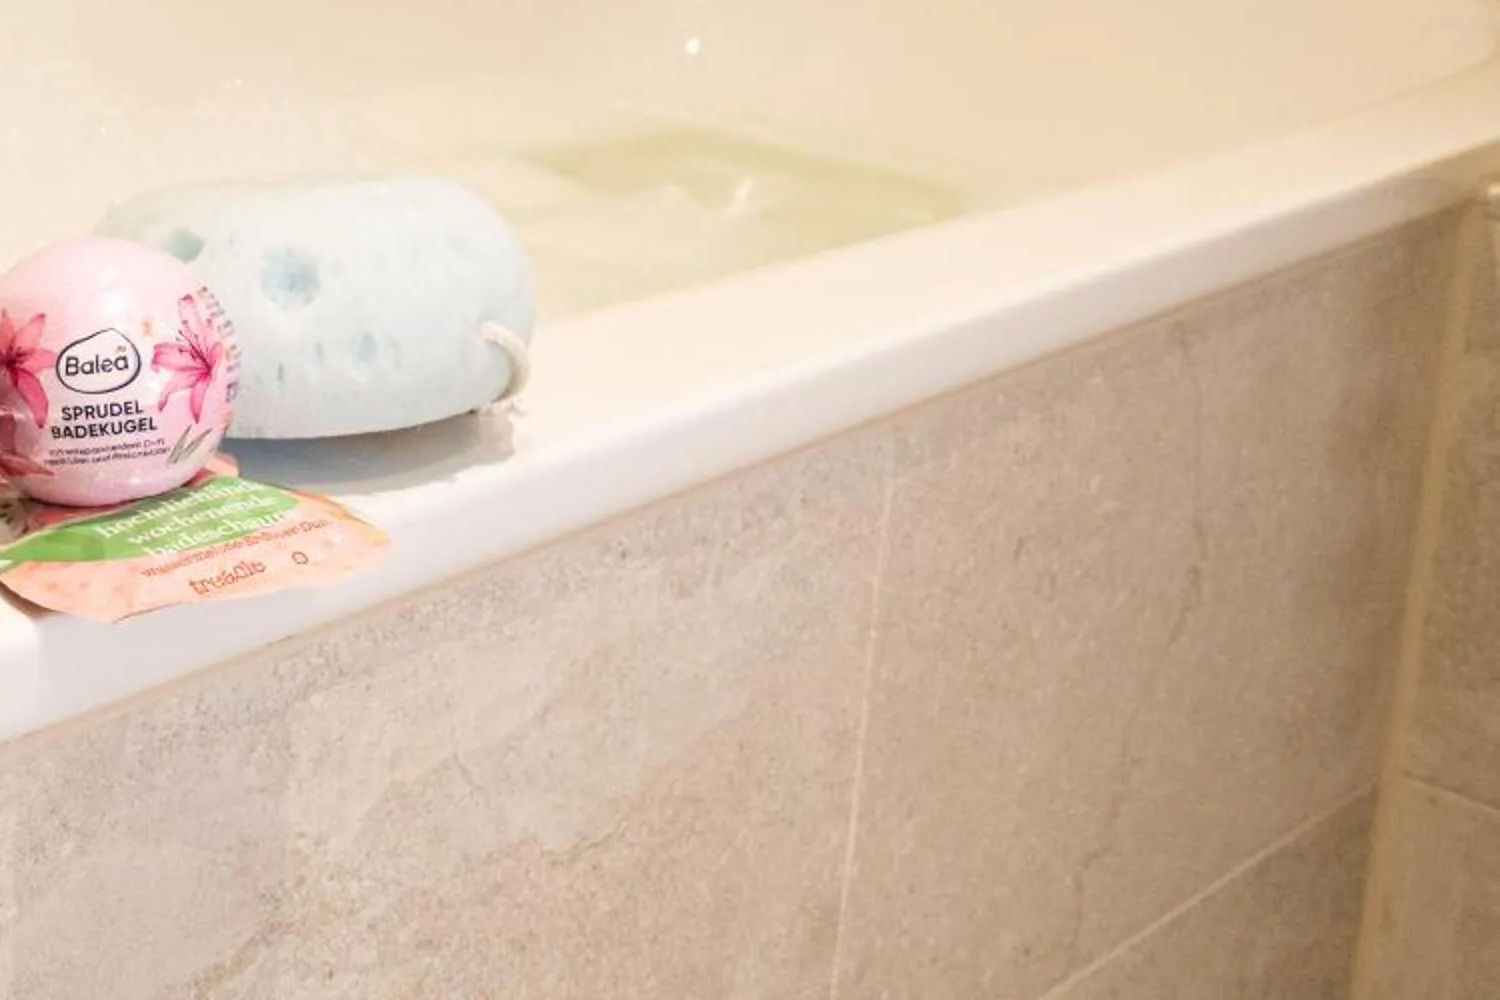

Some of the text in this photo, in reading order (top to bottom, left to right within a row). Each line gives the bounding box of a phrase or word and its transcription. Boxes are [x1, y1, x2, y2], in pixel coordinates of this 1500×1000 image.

[65, 353, 129, 376] Balea
[61, 400, 144, 421] SPRUDEL
[51, 417, 157, 439] BADEKUGEL
